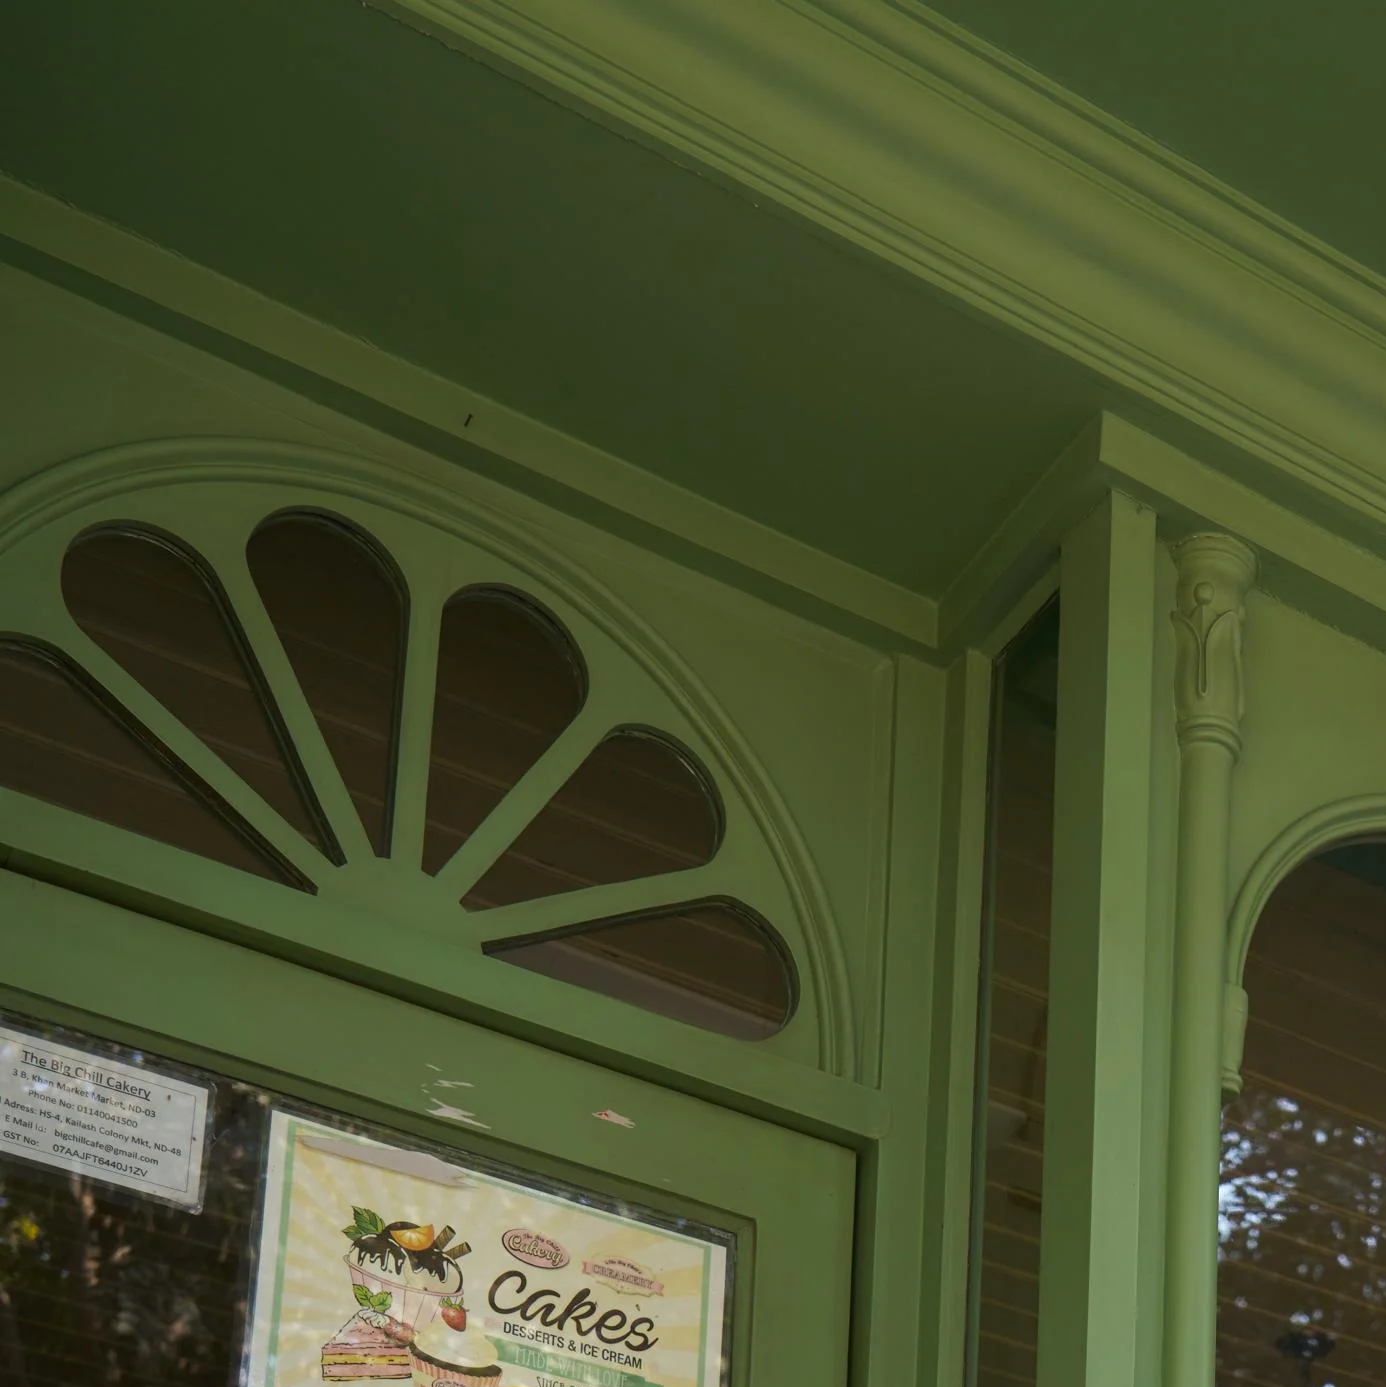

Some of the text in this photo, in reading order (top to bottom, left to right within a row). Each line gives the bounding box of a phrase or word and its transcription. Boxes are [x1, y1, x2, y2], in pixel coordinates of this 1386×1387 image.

[12, 1068, 18, 1077] 3
[32, 1073, 54, 1087] Khan
[56, 1081, 89, 1098] Market
[91, 1091, 126, 1111] Market,
[128, 1103, 156, 1118] ND-03
[22, 1049, 151, 1099] The Big Chill Cakery
[28, 1089, 138, 1129] Phone No: 01140041500
[3, 1130, 22, 1141] GST
[23, 1135, 40, 1147] No:
[12, 1116, 33, 1129] Mail
[54, 1128, 159, 1166] bigchillcafe@gmail.com
[65, 1116, 97, 1132] Kailash
[98, 1126, 130, 1143] Colony
[131, 1135, 151, 1149] Mkt,
[153, 1142, 182, 1157] ND-48
[508, 1235, 564, 1267] Cakery
[487, 1269, 660, 1352] Cakes
[502, 1321, 643, 1370] DESSERTS & ICE CREAM
[514, 1346, 553, 1373] MADE
